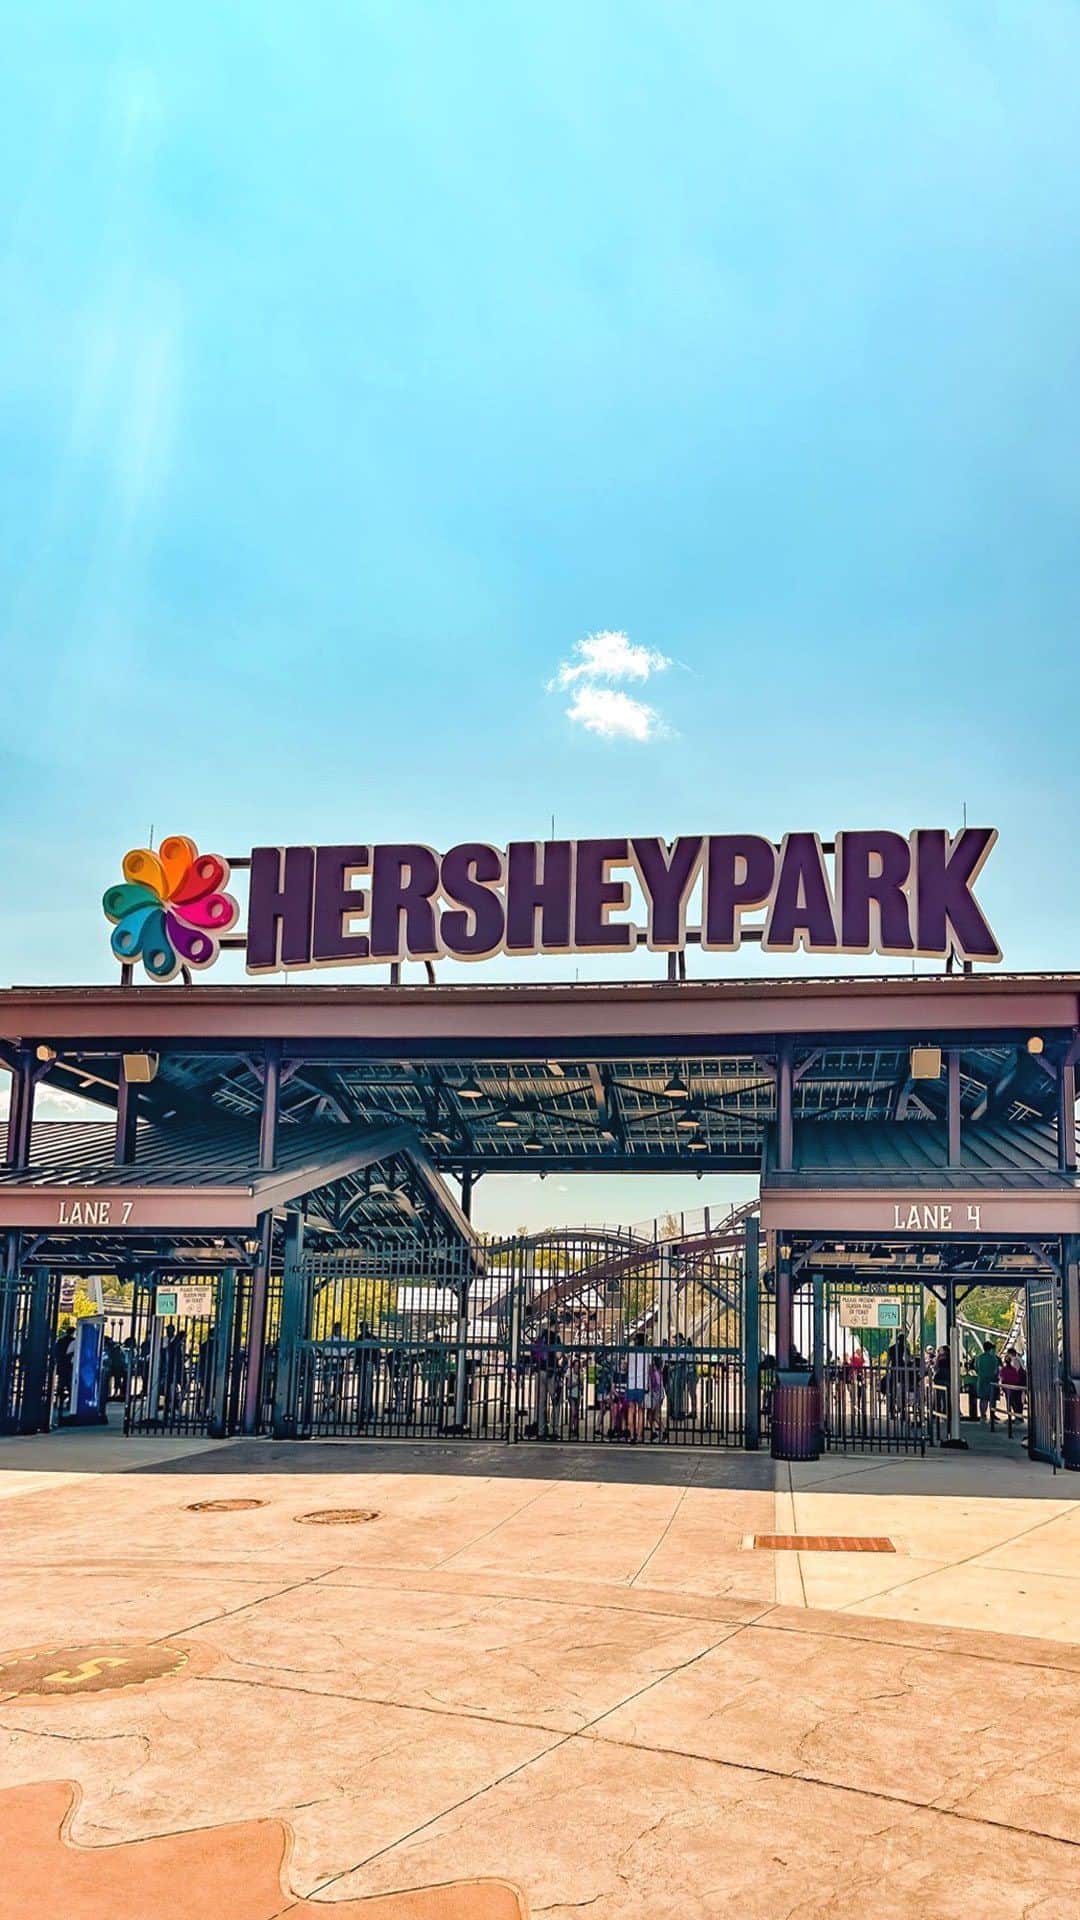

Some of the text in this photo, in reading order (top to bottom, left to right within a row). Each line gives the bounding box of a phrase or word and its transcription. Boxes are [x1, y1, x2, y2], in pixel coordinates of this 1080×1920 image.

[246, 828, 1003, 975] HERSHEYPARK
[59, 1201, 134, 1225] LANE 7
[894, 1204, 981, 1230] LANE 4
